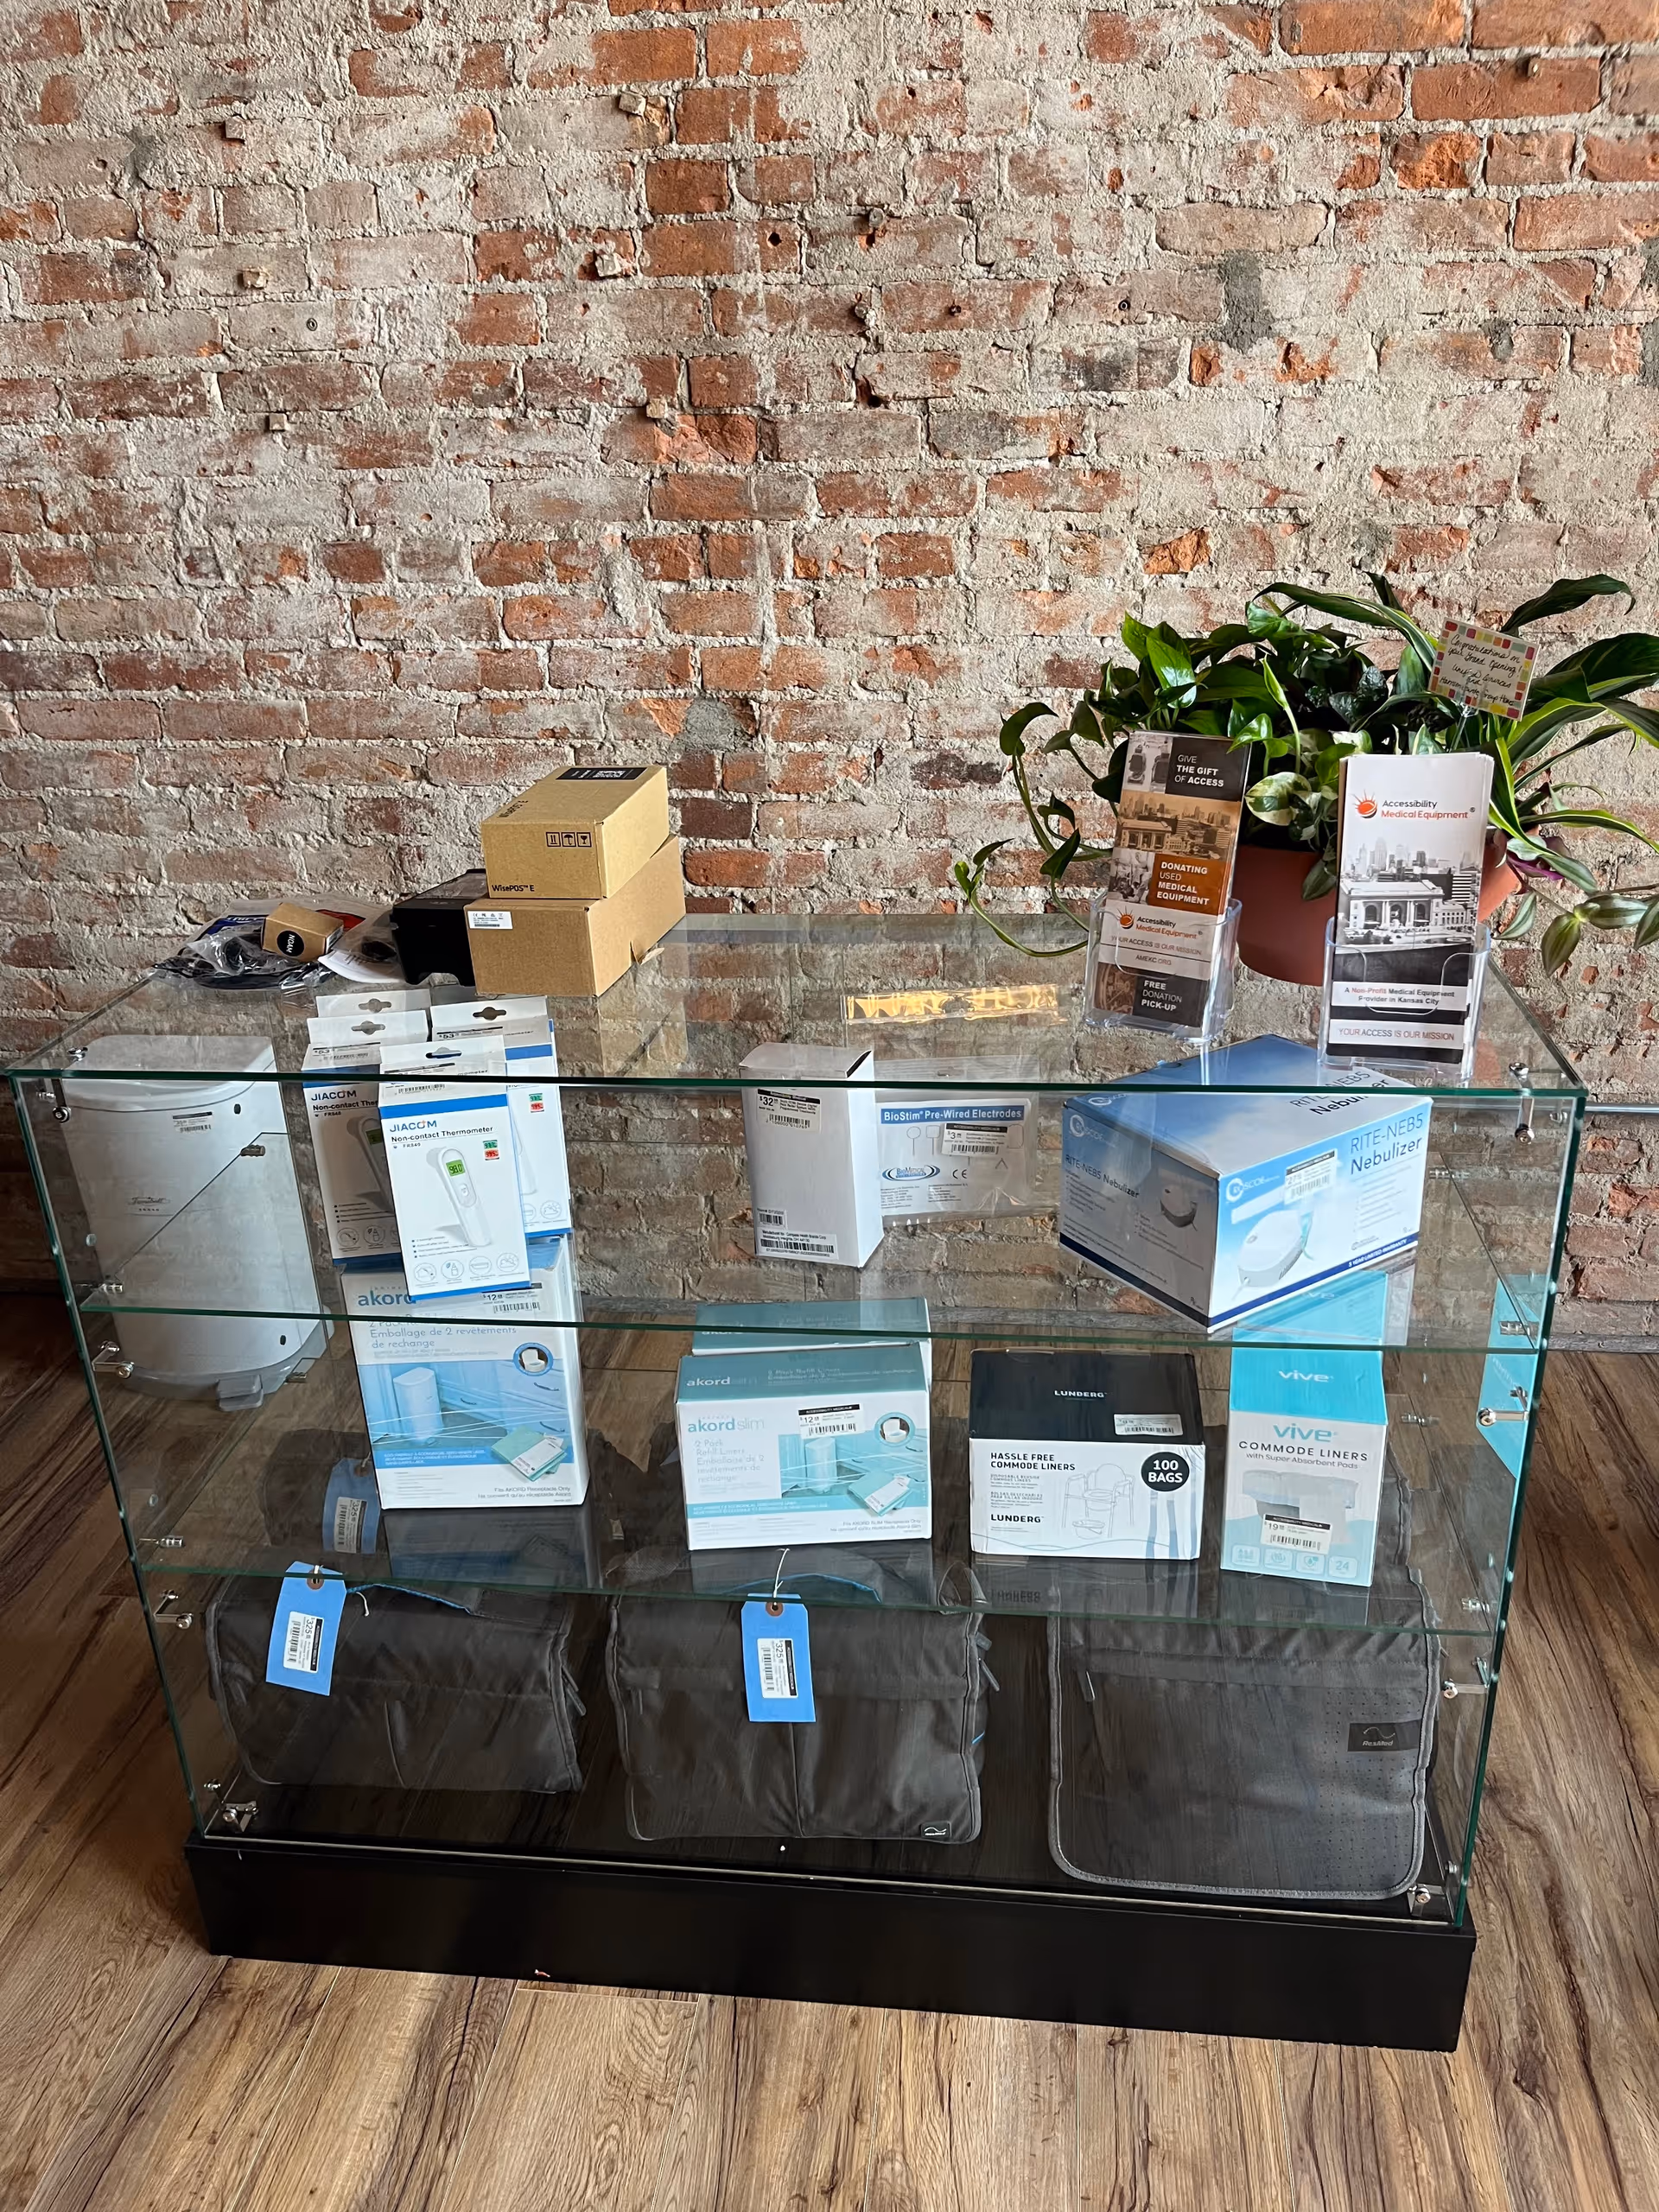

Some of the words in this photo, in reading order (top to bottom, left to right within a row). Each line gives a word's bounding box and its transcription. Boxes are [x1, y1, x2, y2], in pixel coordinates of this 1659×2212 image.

[1178, 754, 1198, 764] GIVE
[1176, 765, 1194, 774] THE
[1197, 766, 1218, 776] GIFT
[1174, 774, 1186, 783] OF
[1187, 776, 1224, 787] ACCESS
[1382, 800, 1438, 809] Accessibility
[1381, 810, 1416, 819] Medical
[1160, 861, 1208, 874] DONATING
[1159, 871, 1182, 881] USED
[1158, 881, 1198, 894] MEDICAL
[1156, 891, 1210, 906] EQUIPMENT
[1136, 916, 1176, 929] Accessibility
[1135, 924, 1161, 935] Medical
[1129, 938, 1153, 948] ACCESS
[1161, 943, 1175, 951] OUR
[1176, 945, 1202, 956] MISSION
[1143, 980, 1166, 990] FREE
[1142, 990, 1182, 1003] DONATION
[1141, 1000, 1177, 1012] PICK-UP
[1422, 1032, 1455, 1041] MISSION
[311, 1090, 357, 1102] JIACOM
[313, 1101, 359, 1111] Non-contact
[925, 1109, 969, 1120] Pre-Wired
[972, 1108, 1021, 1119] Electrodes
[390, 1120, 437, 1133] JIACOM
[391, 1132, 440, 1142] Non-contact
[442, 1127, 493, 1137] Thermometer
[1351, 1113, 1424, 1154] RITE-NEB5
[1351, 1137, 1422, 1175] Nebulizer
[1065, 1154, 1102, 1180] RITE-NEB5
[1103, 1173, 1140, 1198] Nebulizer
[370, 1328, 426, 1338] Emballage
[429, 1327, 442, 1336] de
[445, 1326, 453, 1336] 2
[372, 1339, 385, 1349] de
[388, 1338, 435, 1349] rechange
[686, 1376, 731, 1387] akord
[1279, 1370, 1329, 1382] vive
[1054, 1389, 1104, 1398] LUNDERG
[1273, 1422, 1332, 1442] vive
[1239, 1441, 1314, 1456] COMMODE
[1320, 1449, 1368, 1461] LINERS
[991, 1461, 1038, 1470] COMMODE
[1153, 1459, 1179, 1471] 100
[1265, 1454, 1290, 1463] Super
[1292, 1457, 1335, 1467] Absorbent
[1147, 1471, 1183, 1484] BAGS
[991, 1514, 1041, 1523] LUNDERG
[1335, 1560, 1350, 1571] 24
